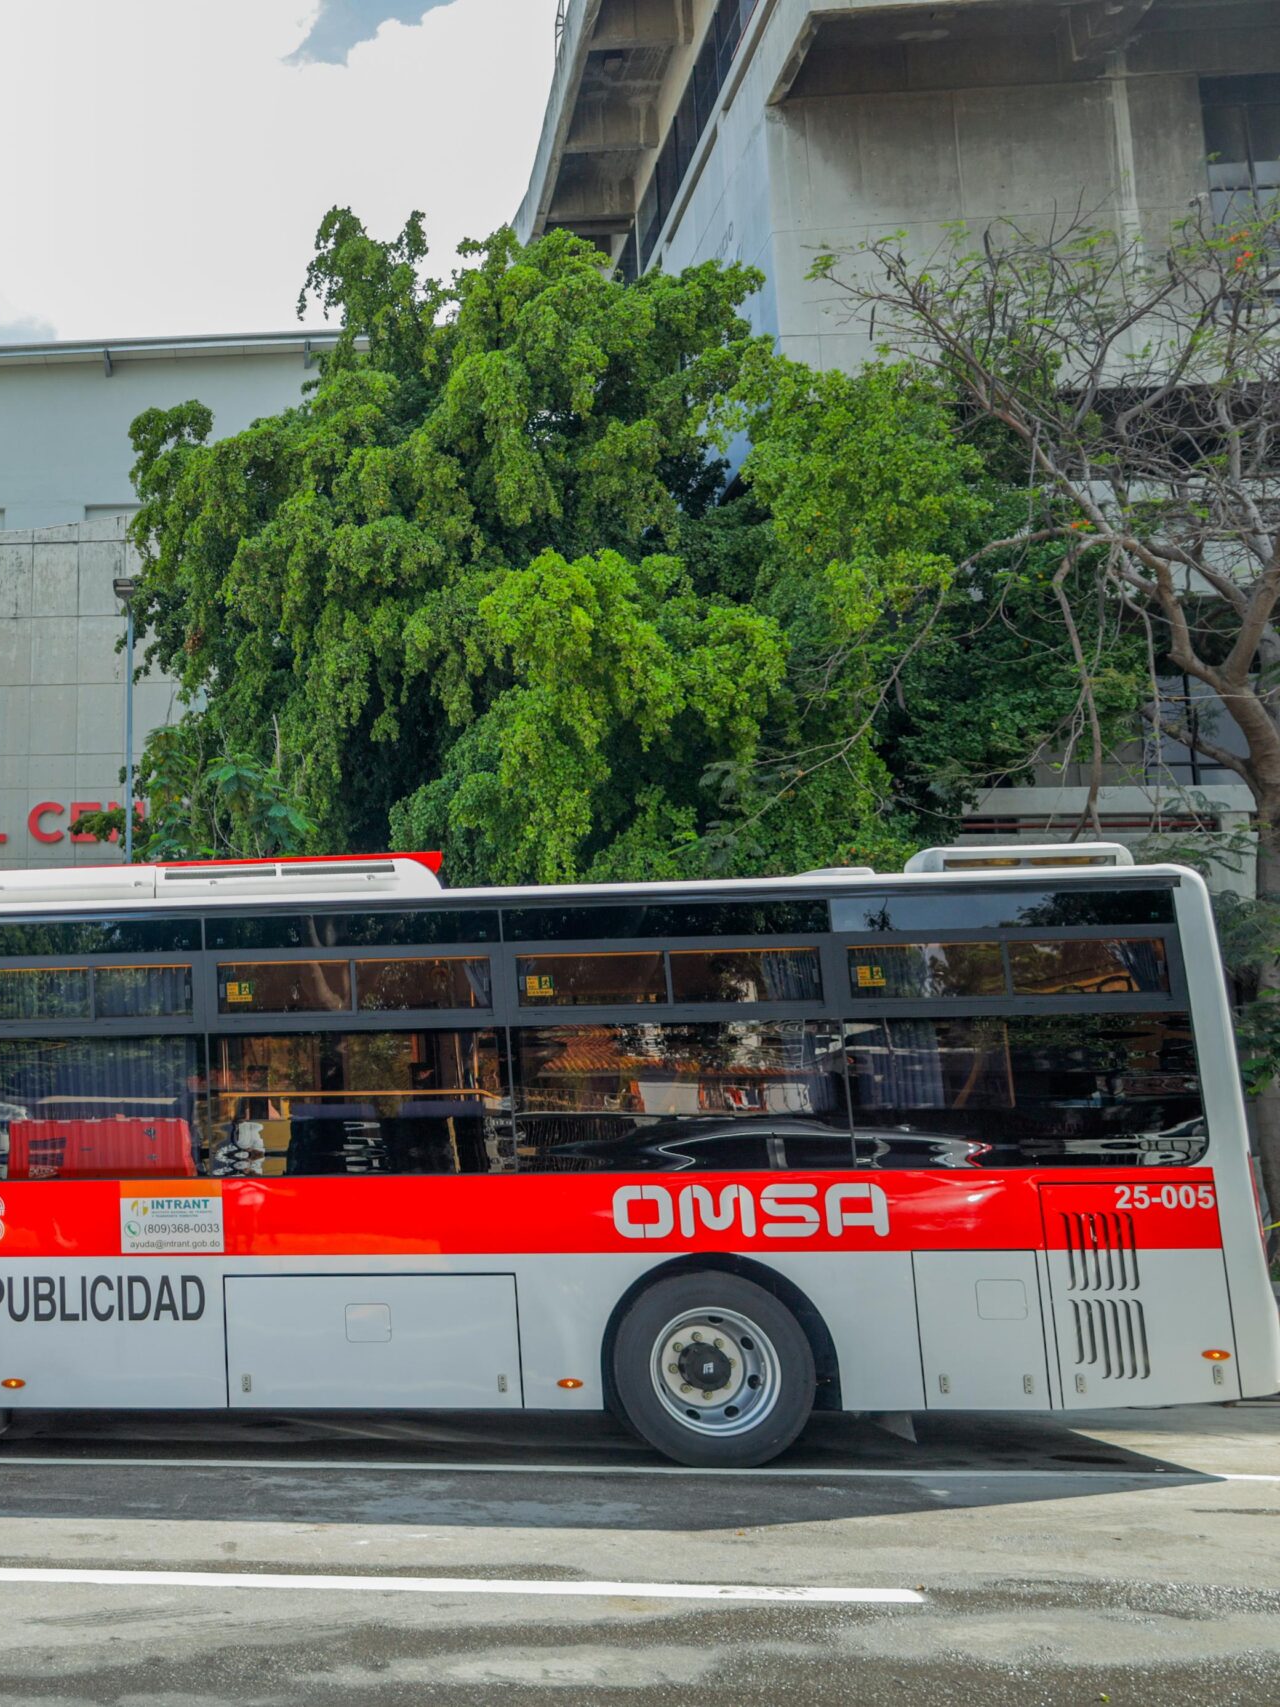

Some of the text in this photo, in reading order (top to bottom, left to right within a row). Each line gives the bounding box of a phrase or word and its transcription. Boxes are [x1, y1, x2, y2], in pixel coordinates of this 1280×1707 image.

[1114, 1185, 1215, 1209] 25-005
[151, 1199, 210, 1210] INTRANT
[612, 1182, 890, 1239] OMSA
[144, 1223, 220, 1235] (809)368-0033
[130, 1239, 221, 1250] ayuda@intrant.gob.do
